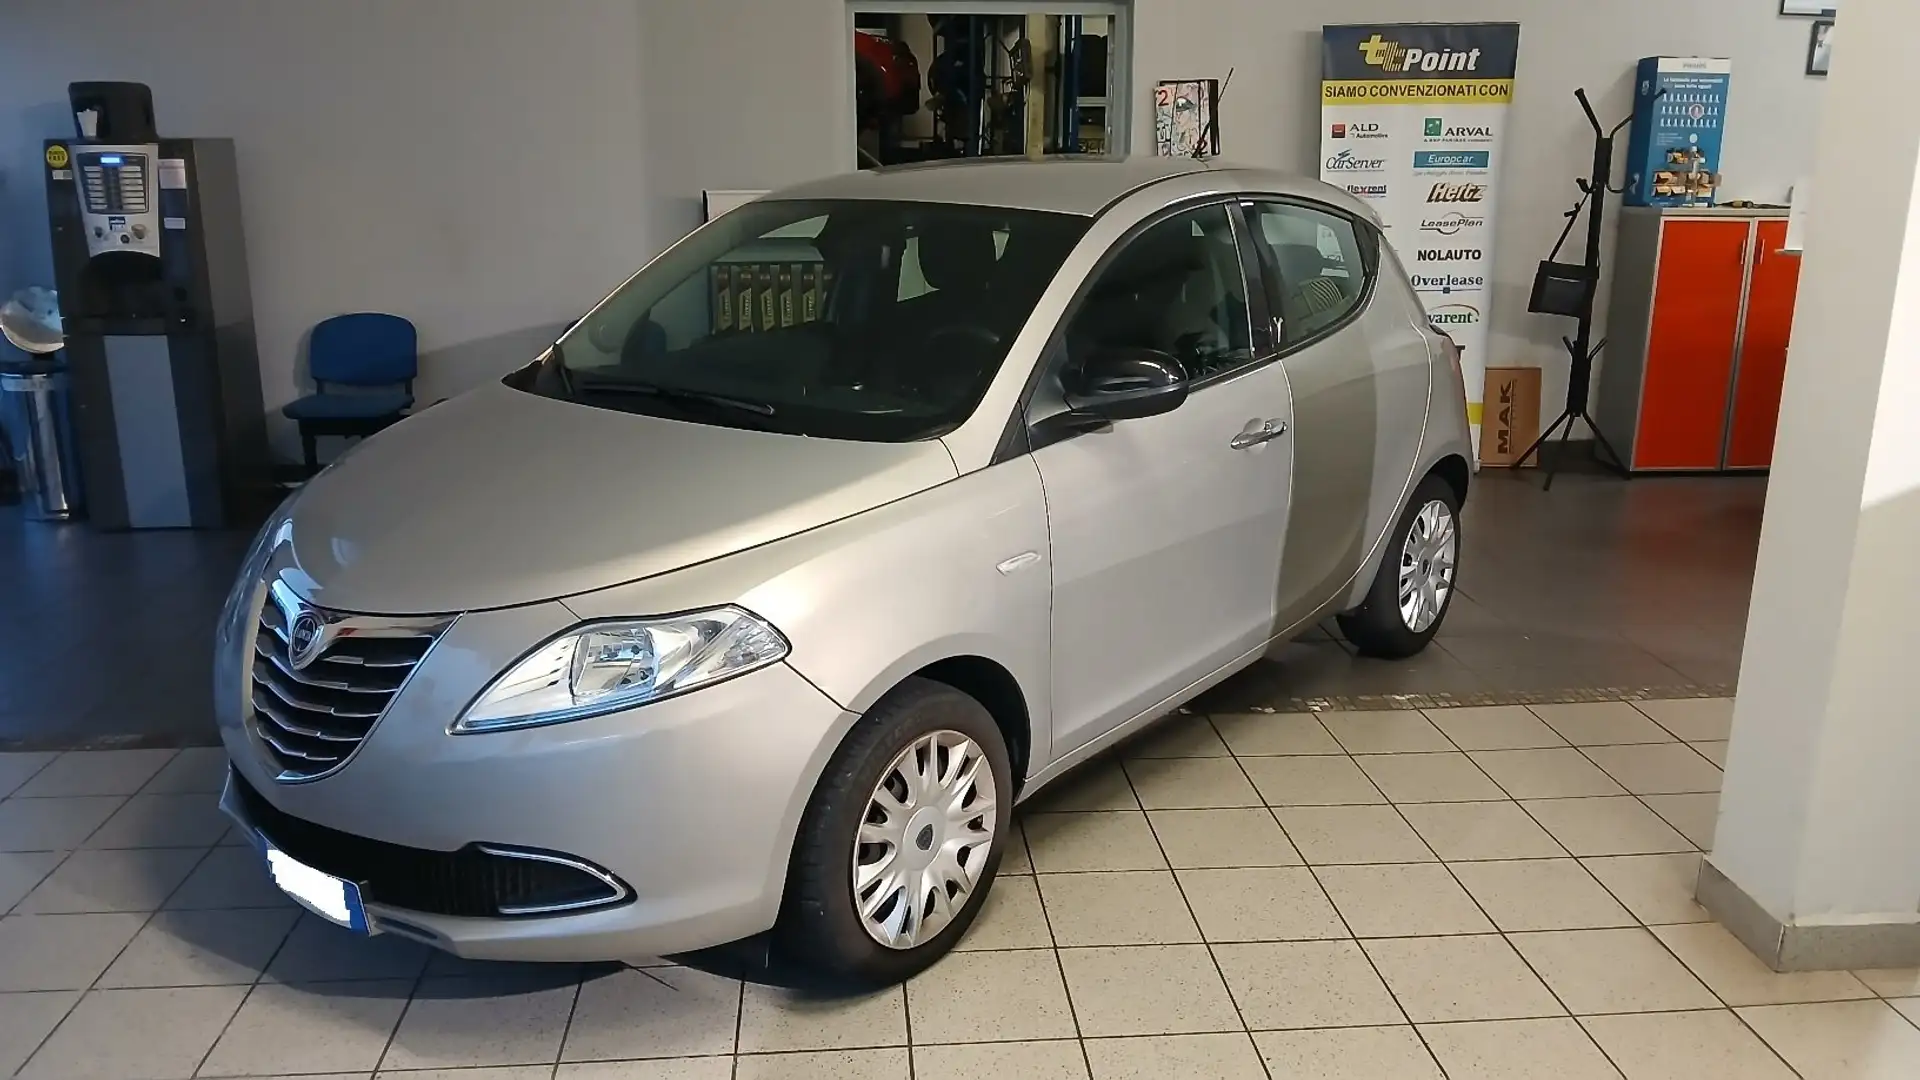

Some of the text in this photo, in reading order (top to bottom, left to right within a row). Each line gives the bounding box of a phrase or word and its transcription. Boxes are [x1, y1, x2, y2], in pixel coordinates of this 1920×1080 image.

[1324, 83, 1509, 98] SIAMO CONVENZIONATI CON
[1157, 89, 1169, 107] 2
[1350, 123, 1379, 132] ALD
[1444, 127, 1493, 137] ARVAL
[1428, 153, 1475, 166] Europcar
[1426, 182, 1488, 203] Hertz
[1421, 218, 1484, 228] LeasePlan
[1417, 249, 1482, 261] NOLAUTO
[1411, 274, 1484, 286] Overlease
[1427, 312, 1473, 324] varent
[1497, 379, 1512, 454] MAK
